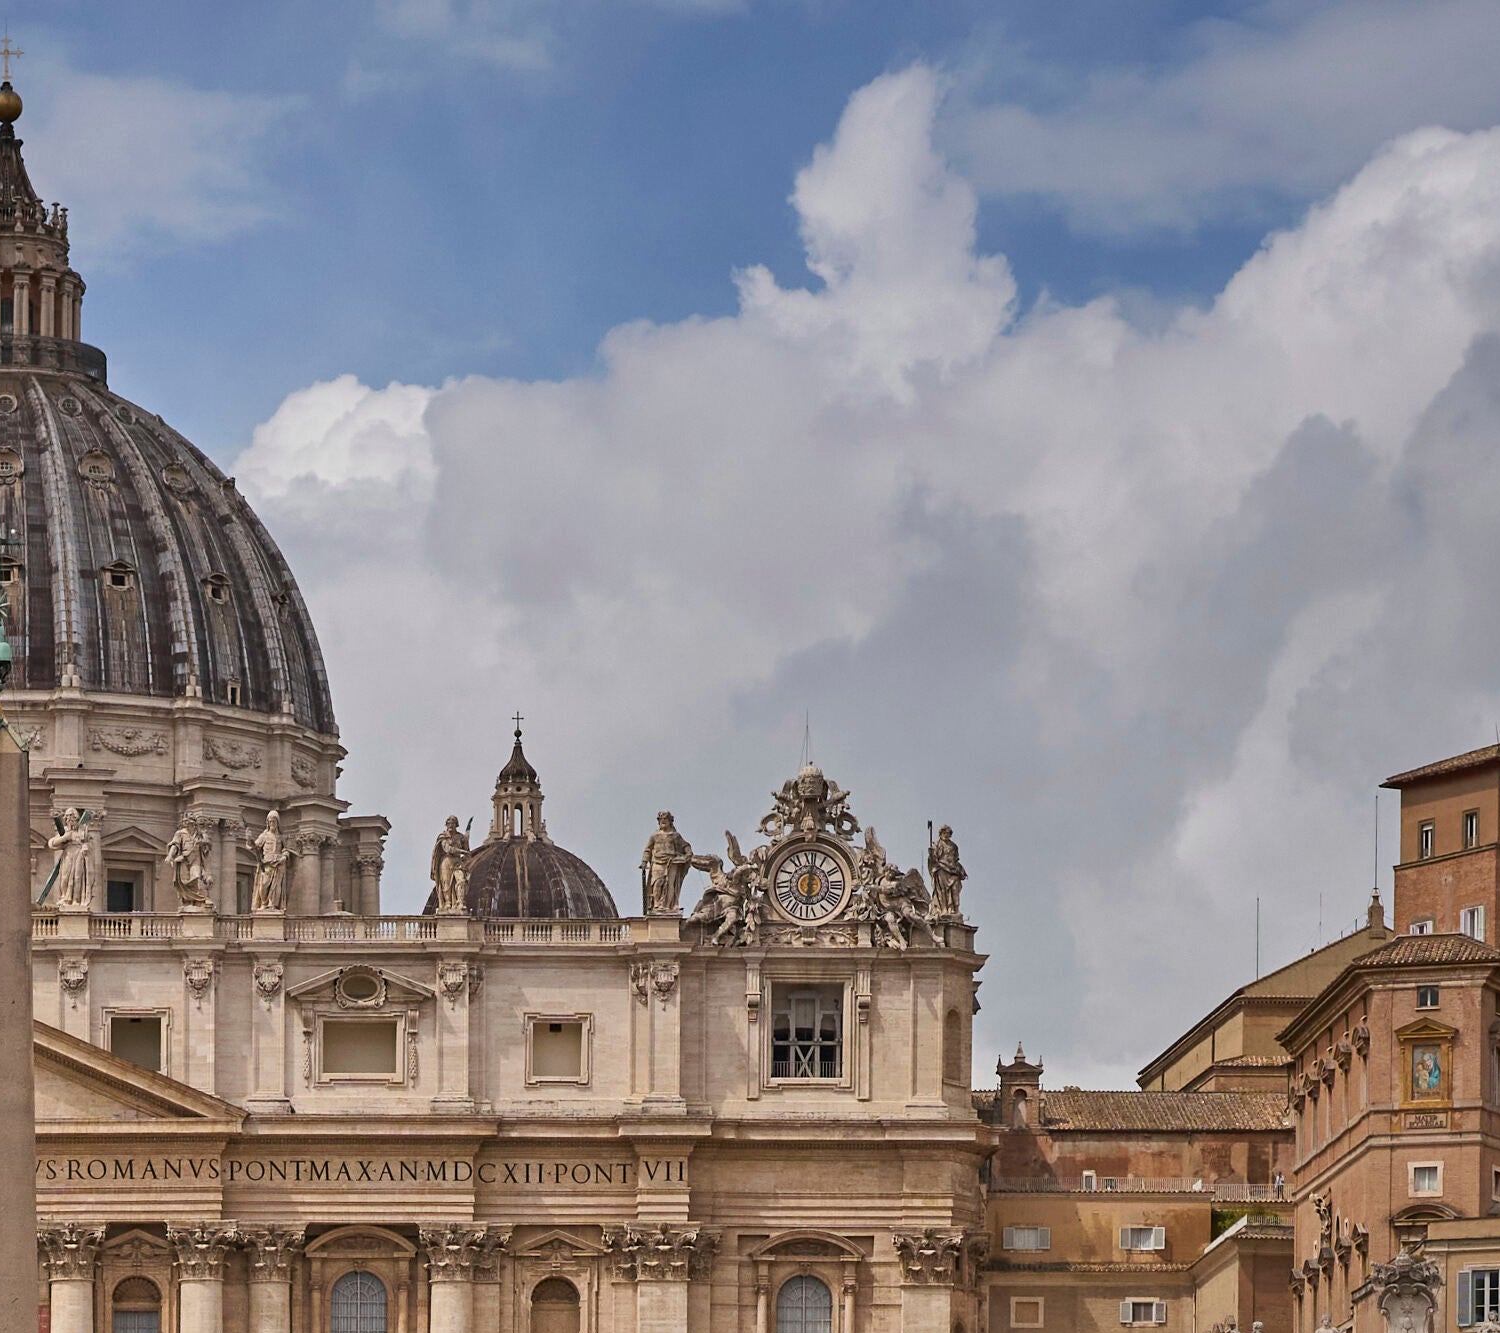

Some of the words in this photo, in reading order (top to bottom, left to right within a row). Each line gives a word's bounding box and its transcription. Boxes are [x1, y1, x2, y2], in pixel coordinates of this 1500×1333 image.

[67, 1159, 220, 1180] ROMANVS
[229, 1160, 306, 1181] PONT
[308, 1160, 373, 1181] MAX
[379, 1160, 418, 1181] AN
[427, 1161, 543, 1183] MDCXII
[555, 1162, 632, 1183] PONT
[643, 1161, 684, 1181] VII
